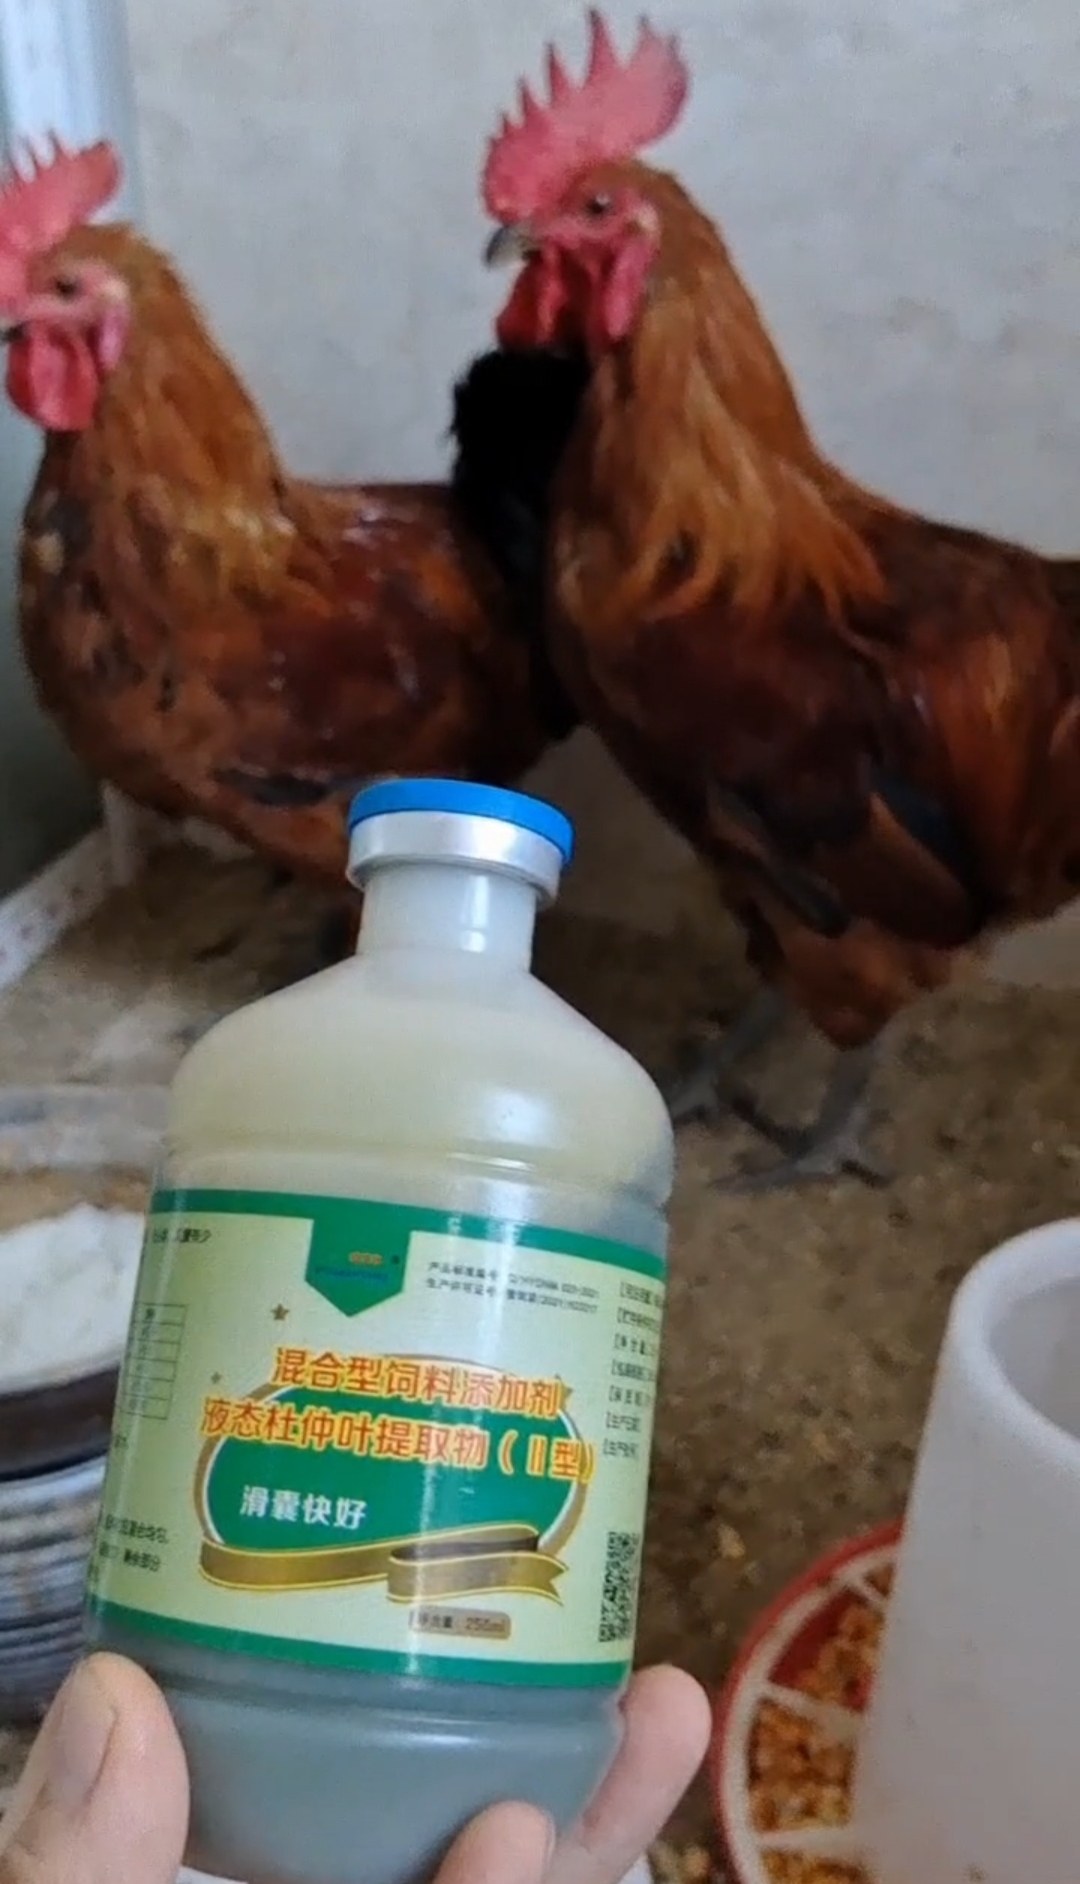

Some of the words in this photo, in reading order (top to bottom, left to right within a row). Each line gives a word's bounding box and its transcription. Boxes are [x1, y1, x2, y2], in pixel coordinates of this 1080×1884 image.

[272, 1346, 562, 1420] 混合型饲料添加剂
[239, 1484, 368, 1530] 滑囊快好
